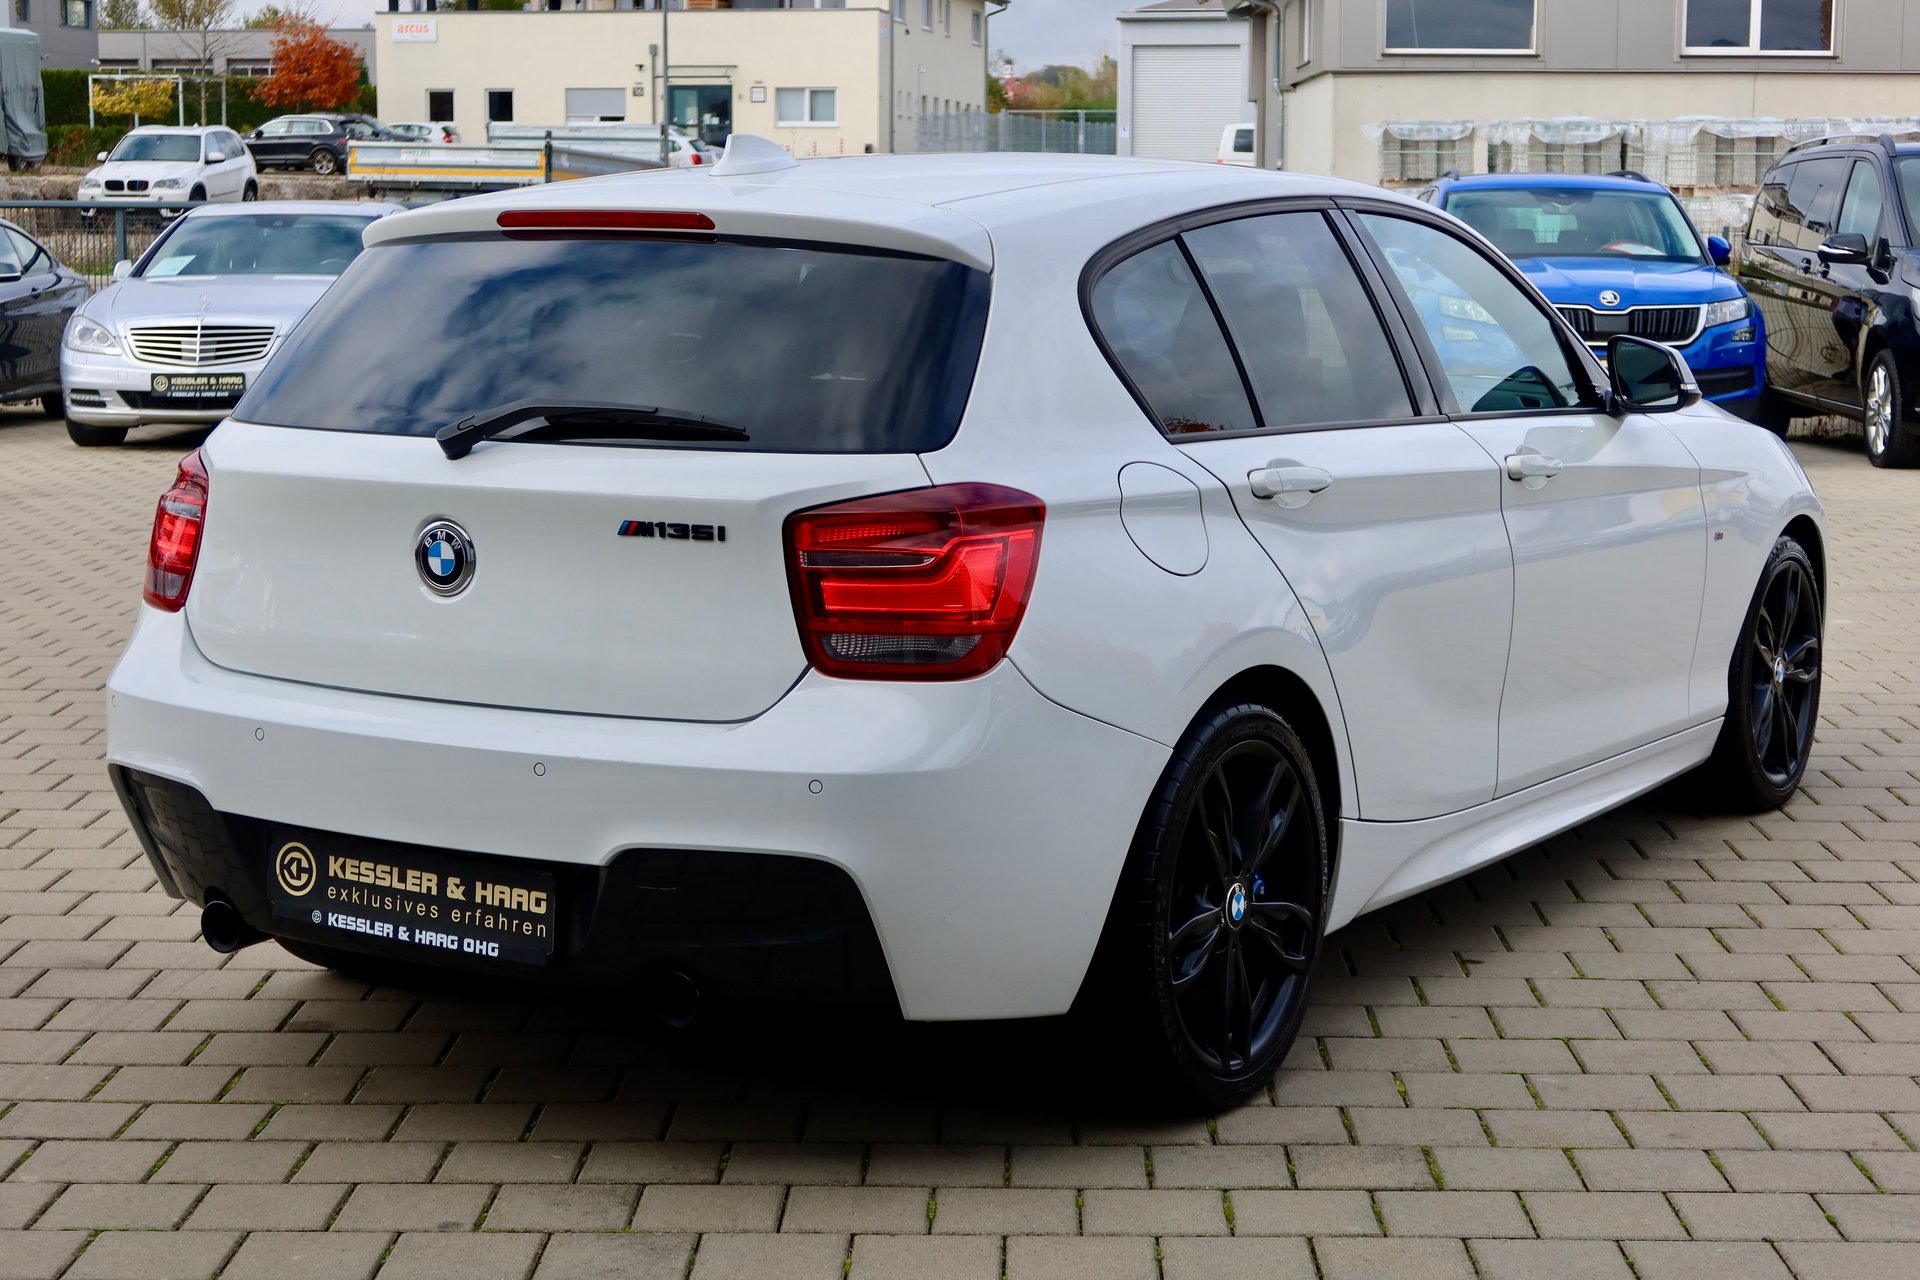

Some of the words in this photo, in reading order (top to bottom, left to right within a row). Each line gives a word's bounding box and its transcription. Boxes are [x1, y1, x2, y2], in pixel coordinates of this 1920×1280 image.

[397, 24, 429, 33] arcus
[170, 376, 208, 384] KESSLER
[218, 376, 243, 384] HAAG
[424, 530, 462, 551] BMW
[328, 855, 438, 896] KESSLER
[446, 877, 467, 901] &
[475, 881, 547, 915] HAAG
[327, 886, 439, 918] exklusives
[451, 909, 546, 938] erfahren
[327, 912, 394, 938] KESSLER
[398, 926, 410, 942] &
[415, 929, 459, 950] HAAG
[463, 938, 499, 957] OHG
